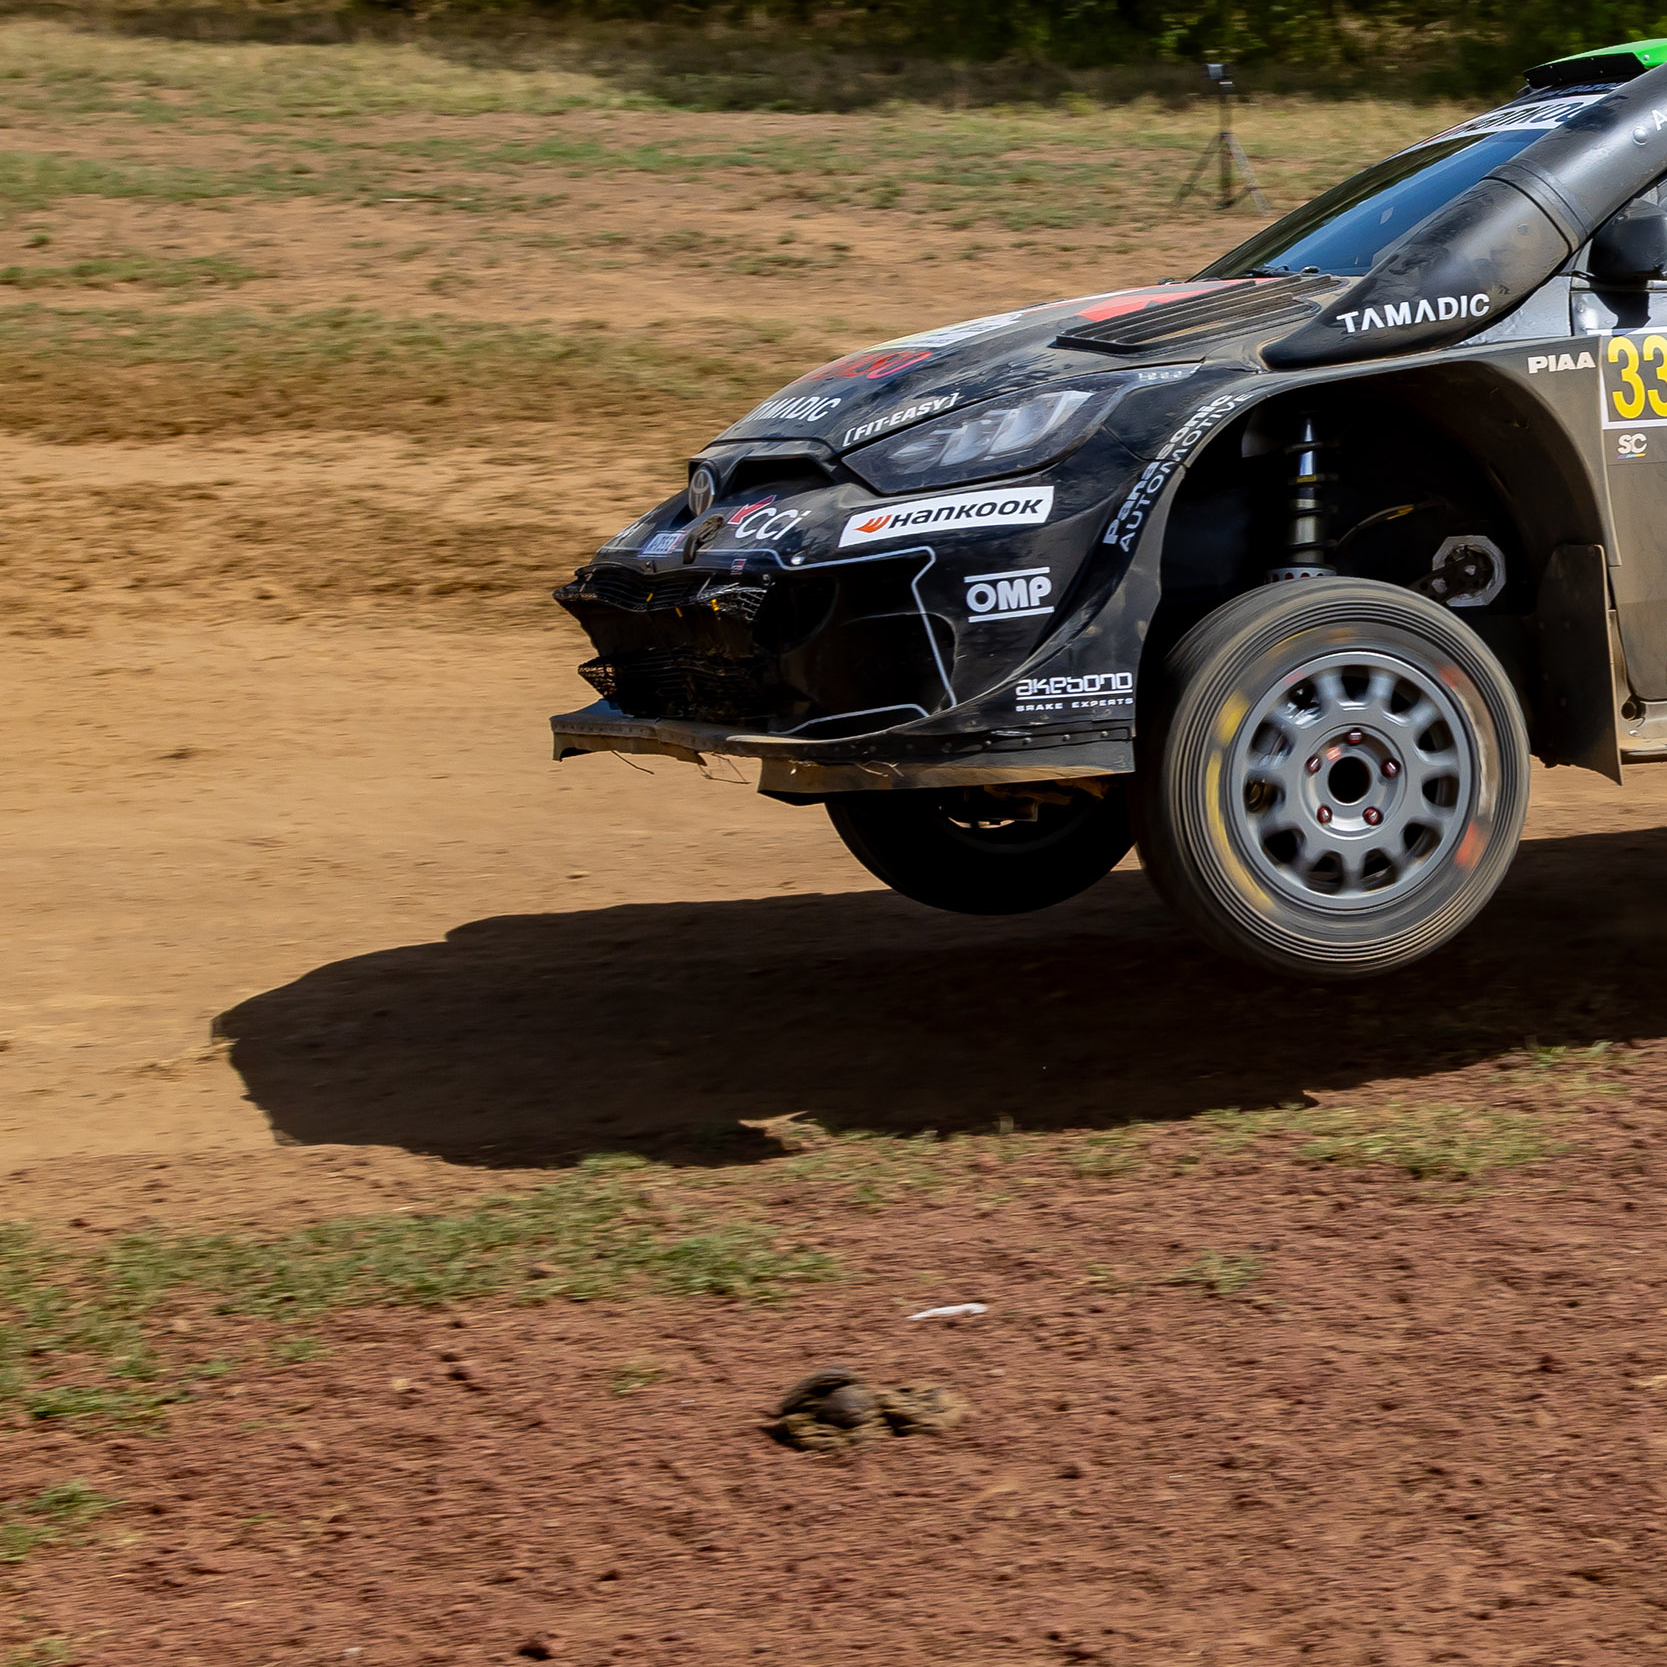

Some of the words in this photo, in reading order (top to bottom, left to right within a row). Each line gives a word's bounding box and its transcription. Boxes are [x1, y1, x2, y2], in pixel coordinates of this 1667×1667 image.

[1336, 293, 1491, 333] TAMADIC
[1527, 351, 1596, 374] PIAA
[1617, 433, 1648, 454] SC
[1102, 394, 1233, 545] Panasonic
[1119, 393, 1254, 553] AUTOMOTIVE
[966, 575, 1053, 614] OMP
[1015, 702, 1064, 712] BRAKE
[1071, 697, 1134, 709] EXPERTS
